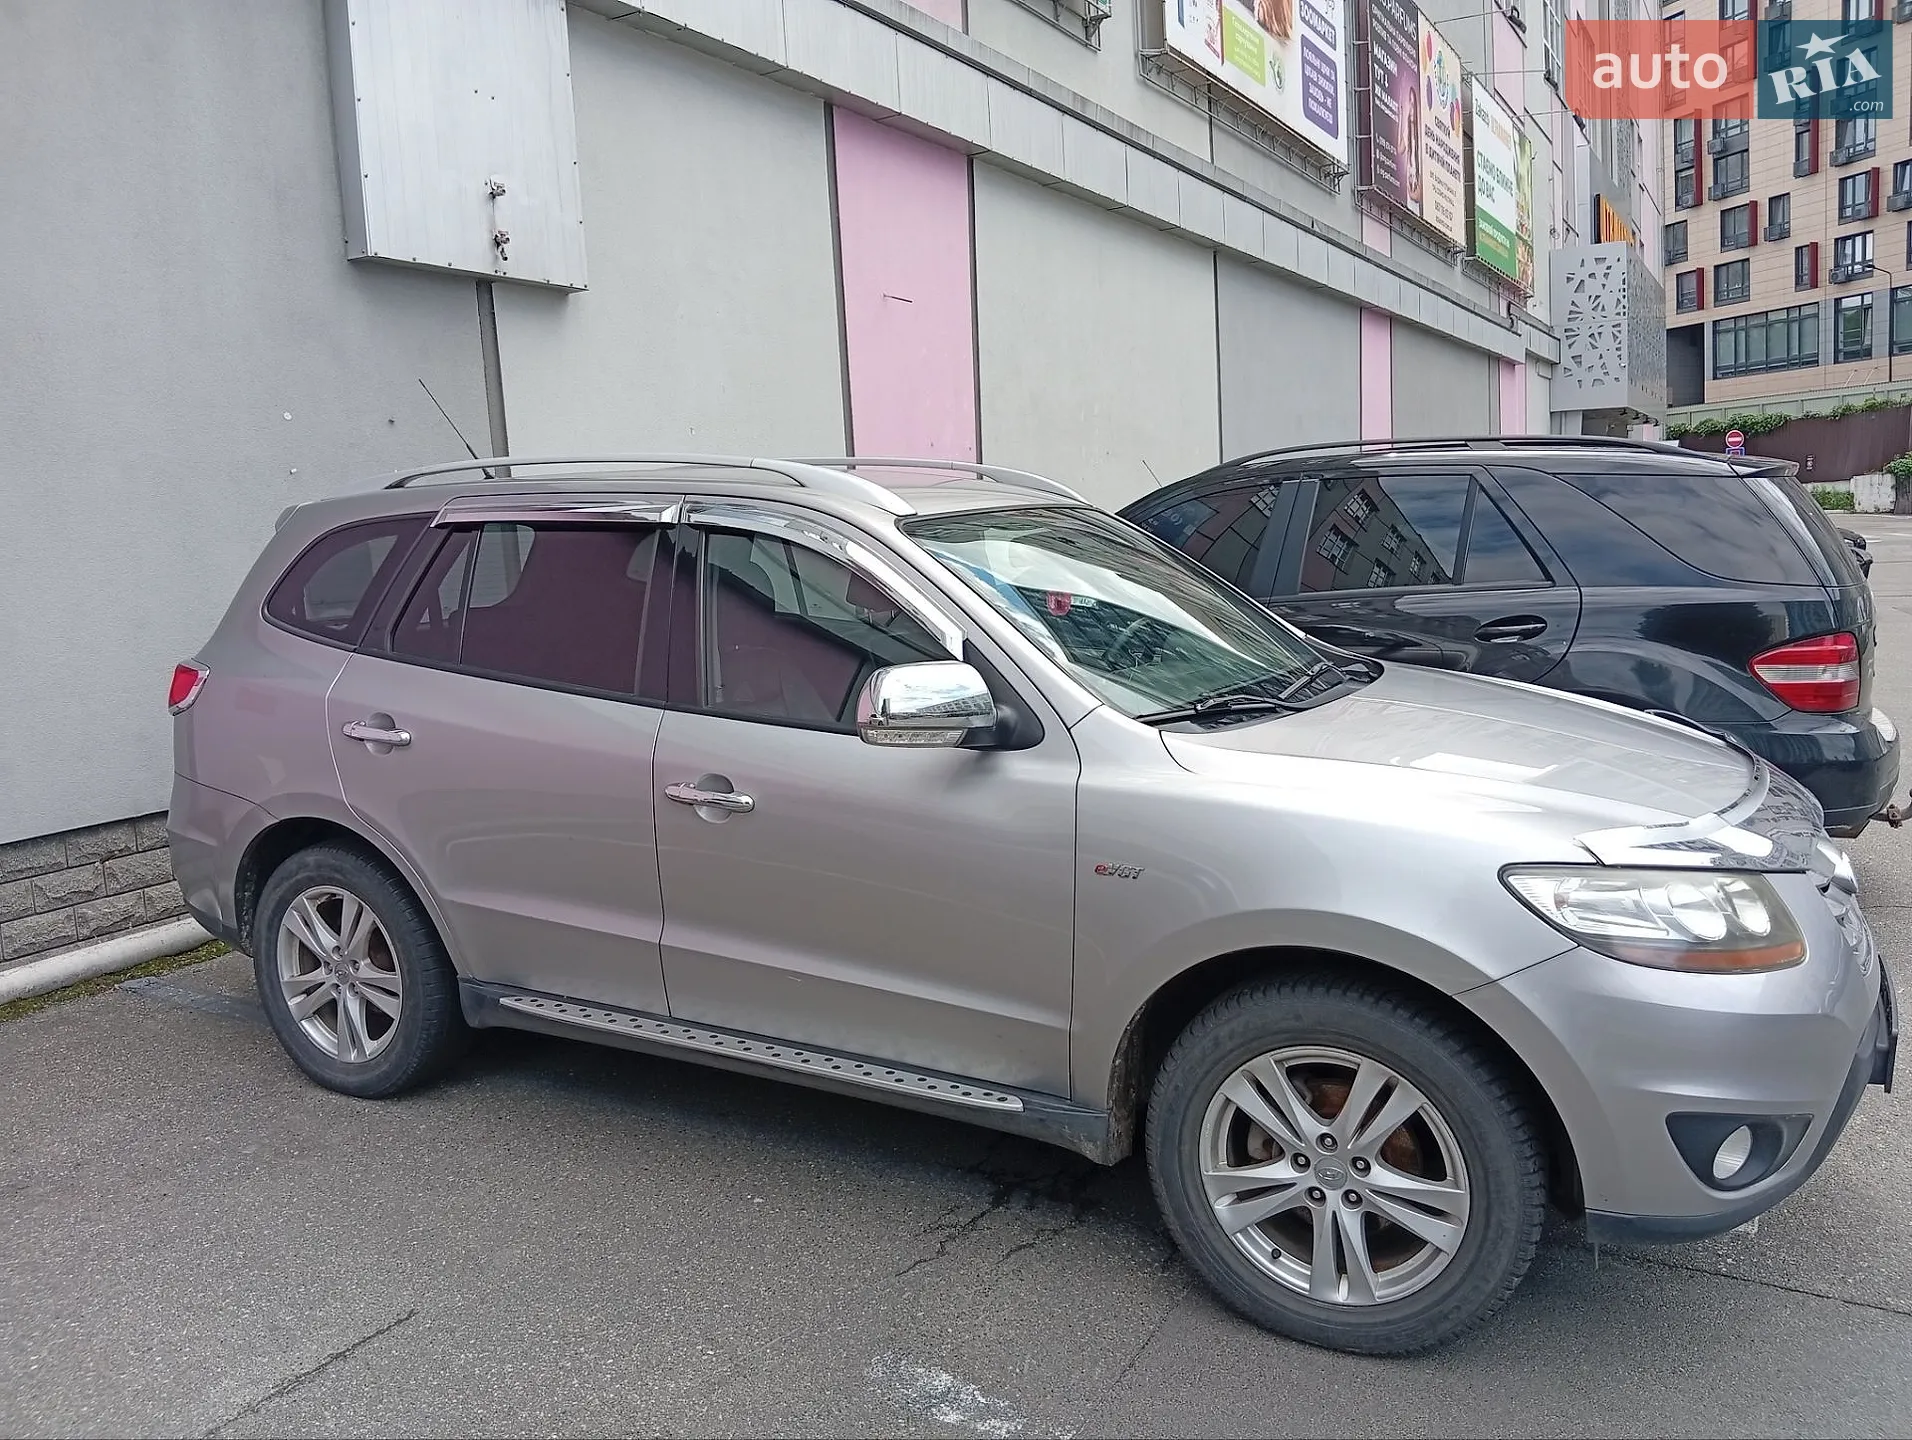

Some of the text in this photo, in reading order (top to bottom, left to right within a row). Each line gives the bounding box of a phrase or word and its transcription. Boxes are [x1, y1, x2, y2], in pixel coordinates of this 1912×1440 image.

[1300, 0, 1335, 45] ЗООМАРКЕТ
[1373, 41, 1398, 77] МАГАЗИН
[1373, 62, 1384, 84] ТУТ
[1477, 174, 1486, 199] ДО
[1486, 181, 1495, 204] ВАС
